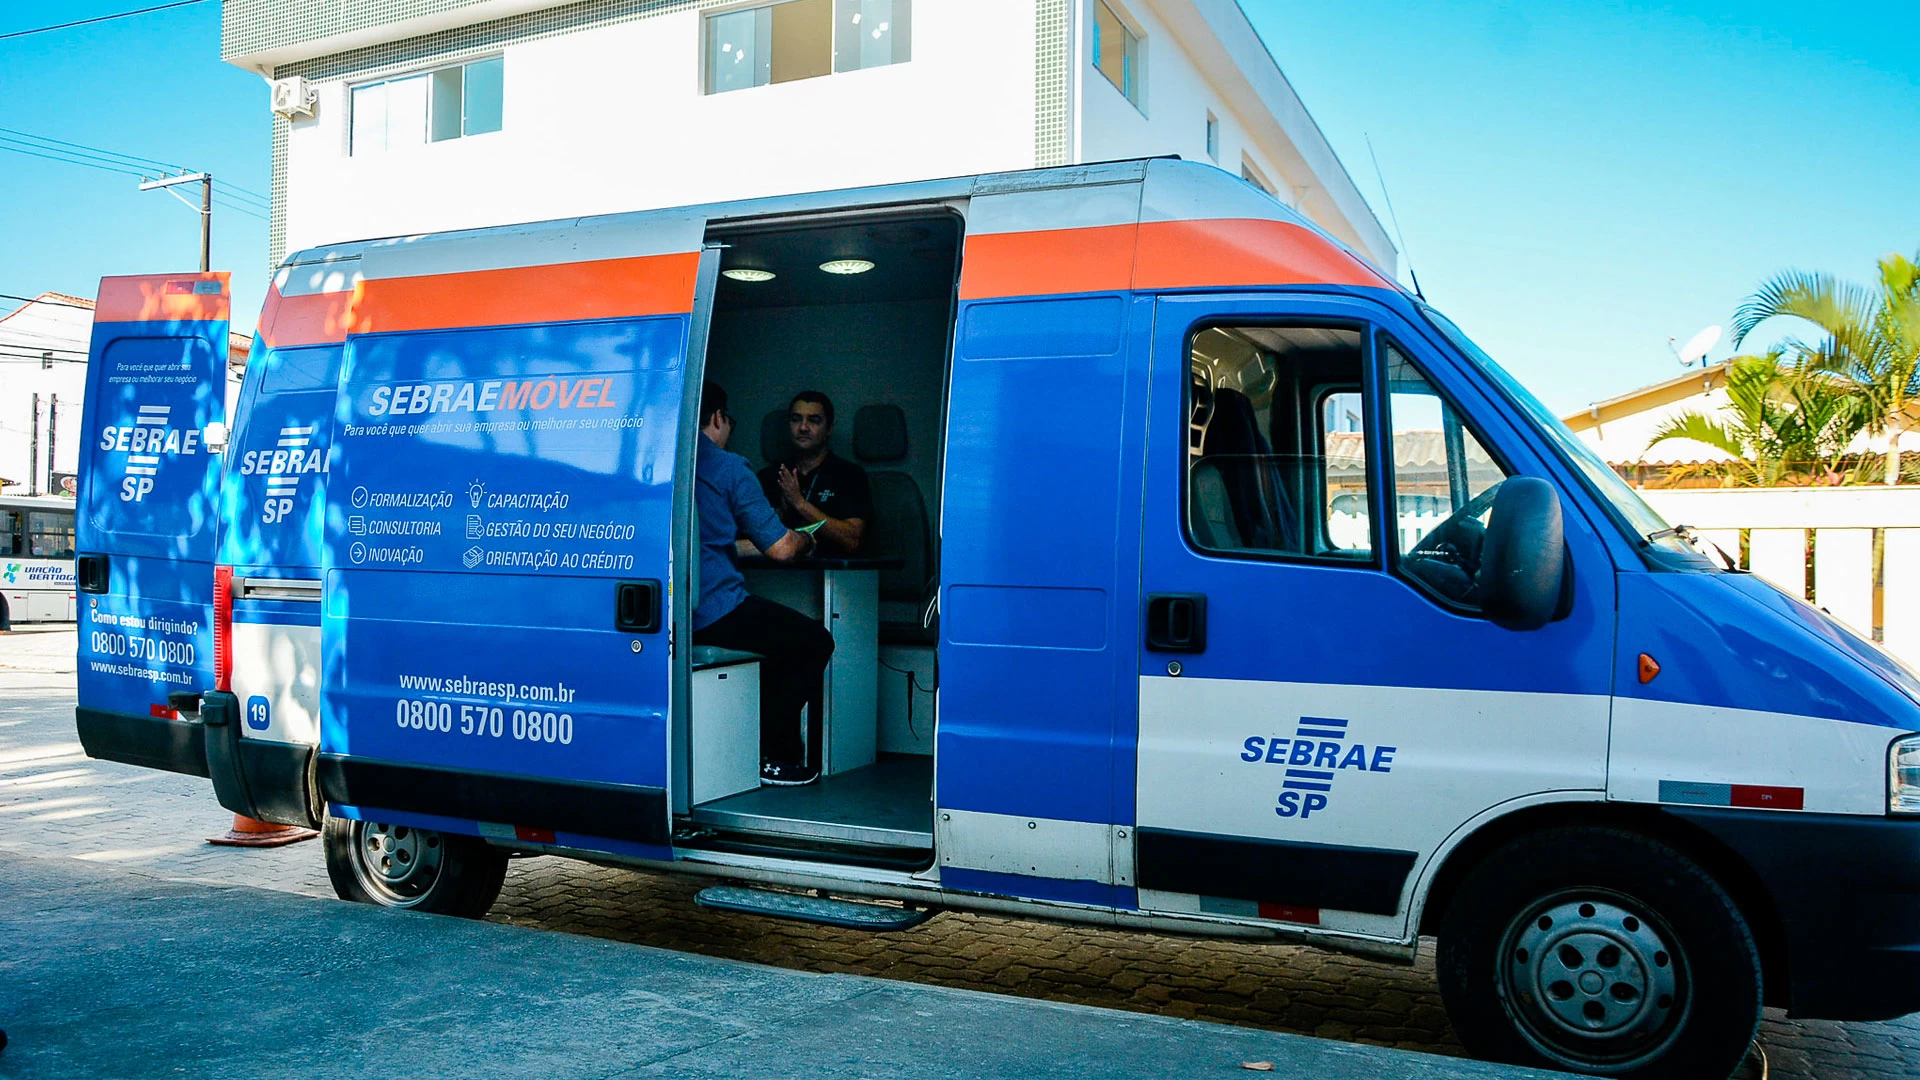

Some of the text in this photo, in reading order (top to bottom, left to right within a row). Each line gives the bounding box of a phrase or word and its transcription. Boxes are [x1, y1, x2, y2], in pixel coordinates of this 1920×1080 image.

[116, 362, 129, 371] Para
[129, 362, 143, 371] você
[154, 364, 167, 372] quer
[167, 362, 180, 371] abrir
[109, 375, 132, 384] empresa
[140, 374, 163, 383] melhorar
[174, 374, 198, 385] negócio
[343, 414, 644, 438] Para você que quer abrir sua empresa ou melhorar seu negócio
[100, 426, 201, 455] SEBRAE
[120, 476, 154, 502] SP
[369, 490, 453, 511] FORMALIZAÇÃO
[262, 498, 294, 524] SP
[487, 491, 569, 513] CAPACITAÇÃO
[368, 520, 441, 536] CONSULTORIA
[486, 519, 635, 540] GESTÃO DO SEU NEGÓCIO
[368, 546, 424, 566] INOVAÇÃO
[486, 549, 634, 571] ORIENTAÇÃO AO CRÉDITO
[91, 608, 198, 636] Como estou dirigindo?
[91, 631, 195, 666] 0800 570 0800
[90, 661, 193, 685] www.sebraesp.com.br
[399, 675, 576, 703] www.sebraesp.com.br
[251, 703, 267, 722] 19
[396, 699, 573, 745] 0800 570 0800
[1240, 736, 1397, 773] SEBRAE
[1275, 790, 1328, 819] SP
